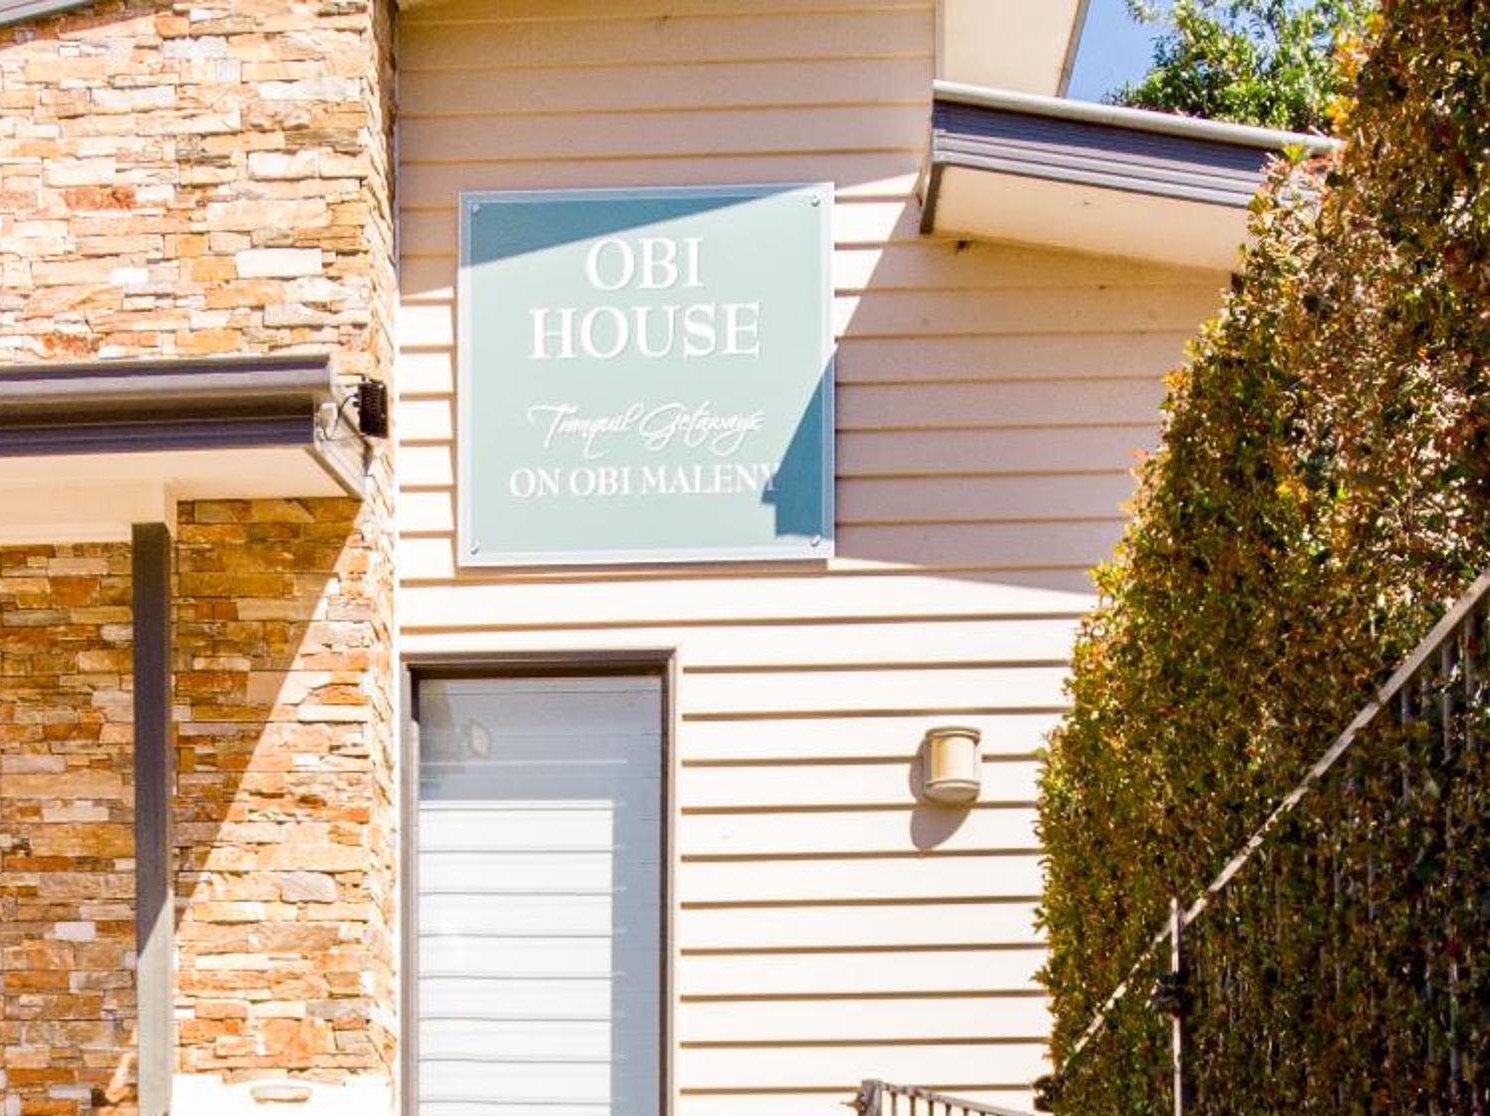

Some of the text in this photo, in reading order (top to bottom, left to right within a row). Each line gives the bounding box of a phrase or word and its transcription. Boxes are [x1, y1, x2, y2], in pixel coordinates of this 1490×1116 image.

[586, 236, 705, 291] OBI
[528, 300, 763, 360] HOUSE
[639, 400, 766, 457] Getaways
[509, 462, 784, 498] ON OBI MALENY
